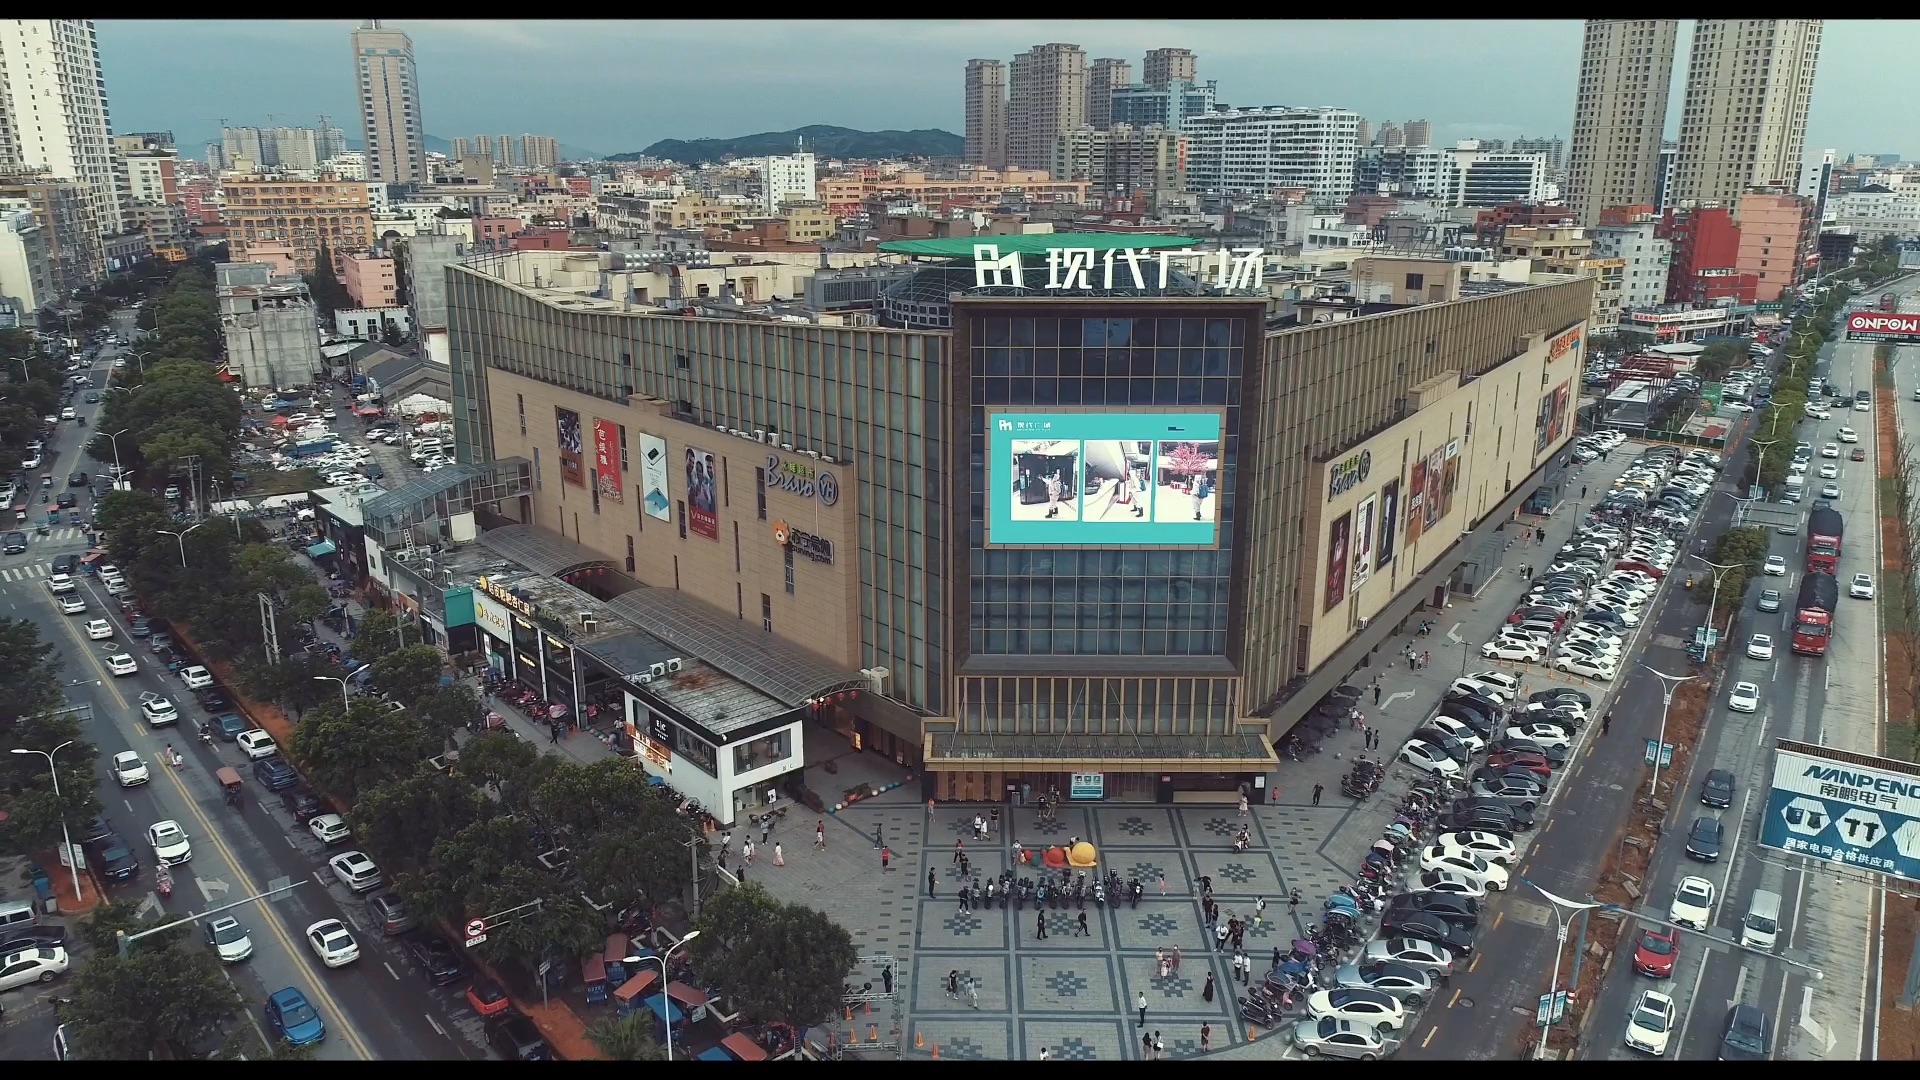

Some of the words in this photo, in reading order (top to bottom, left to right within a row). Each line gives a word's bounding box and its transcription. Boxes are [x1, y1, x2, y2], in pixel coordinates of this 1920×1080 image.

[1044, 247, 1264, 290] 现代广场
[1852, 317, 1918, 331] ONPOW
[765, 454, 815, 497] Bravo
[792, 546, 831, 565] suning.com
[1819, 783, 1899, 810] 南鹏电气
[1784, 837, 1895, 870] 国家电网合格供应商
